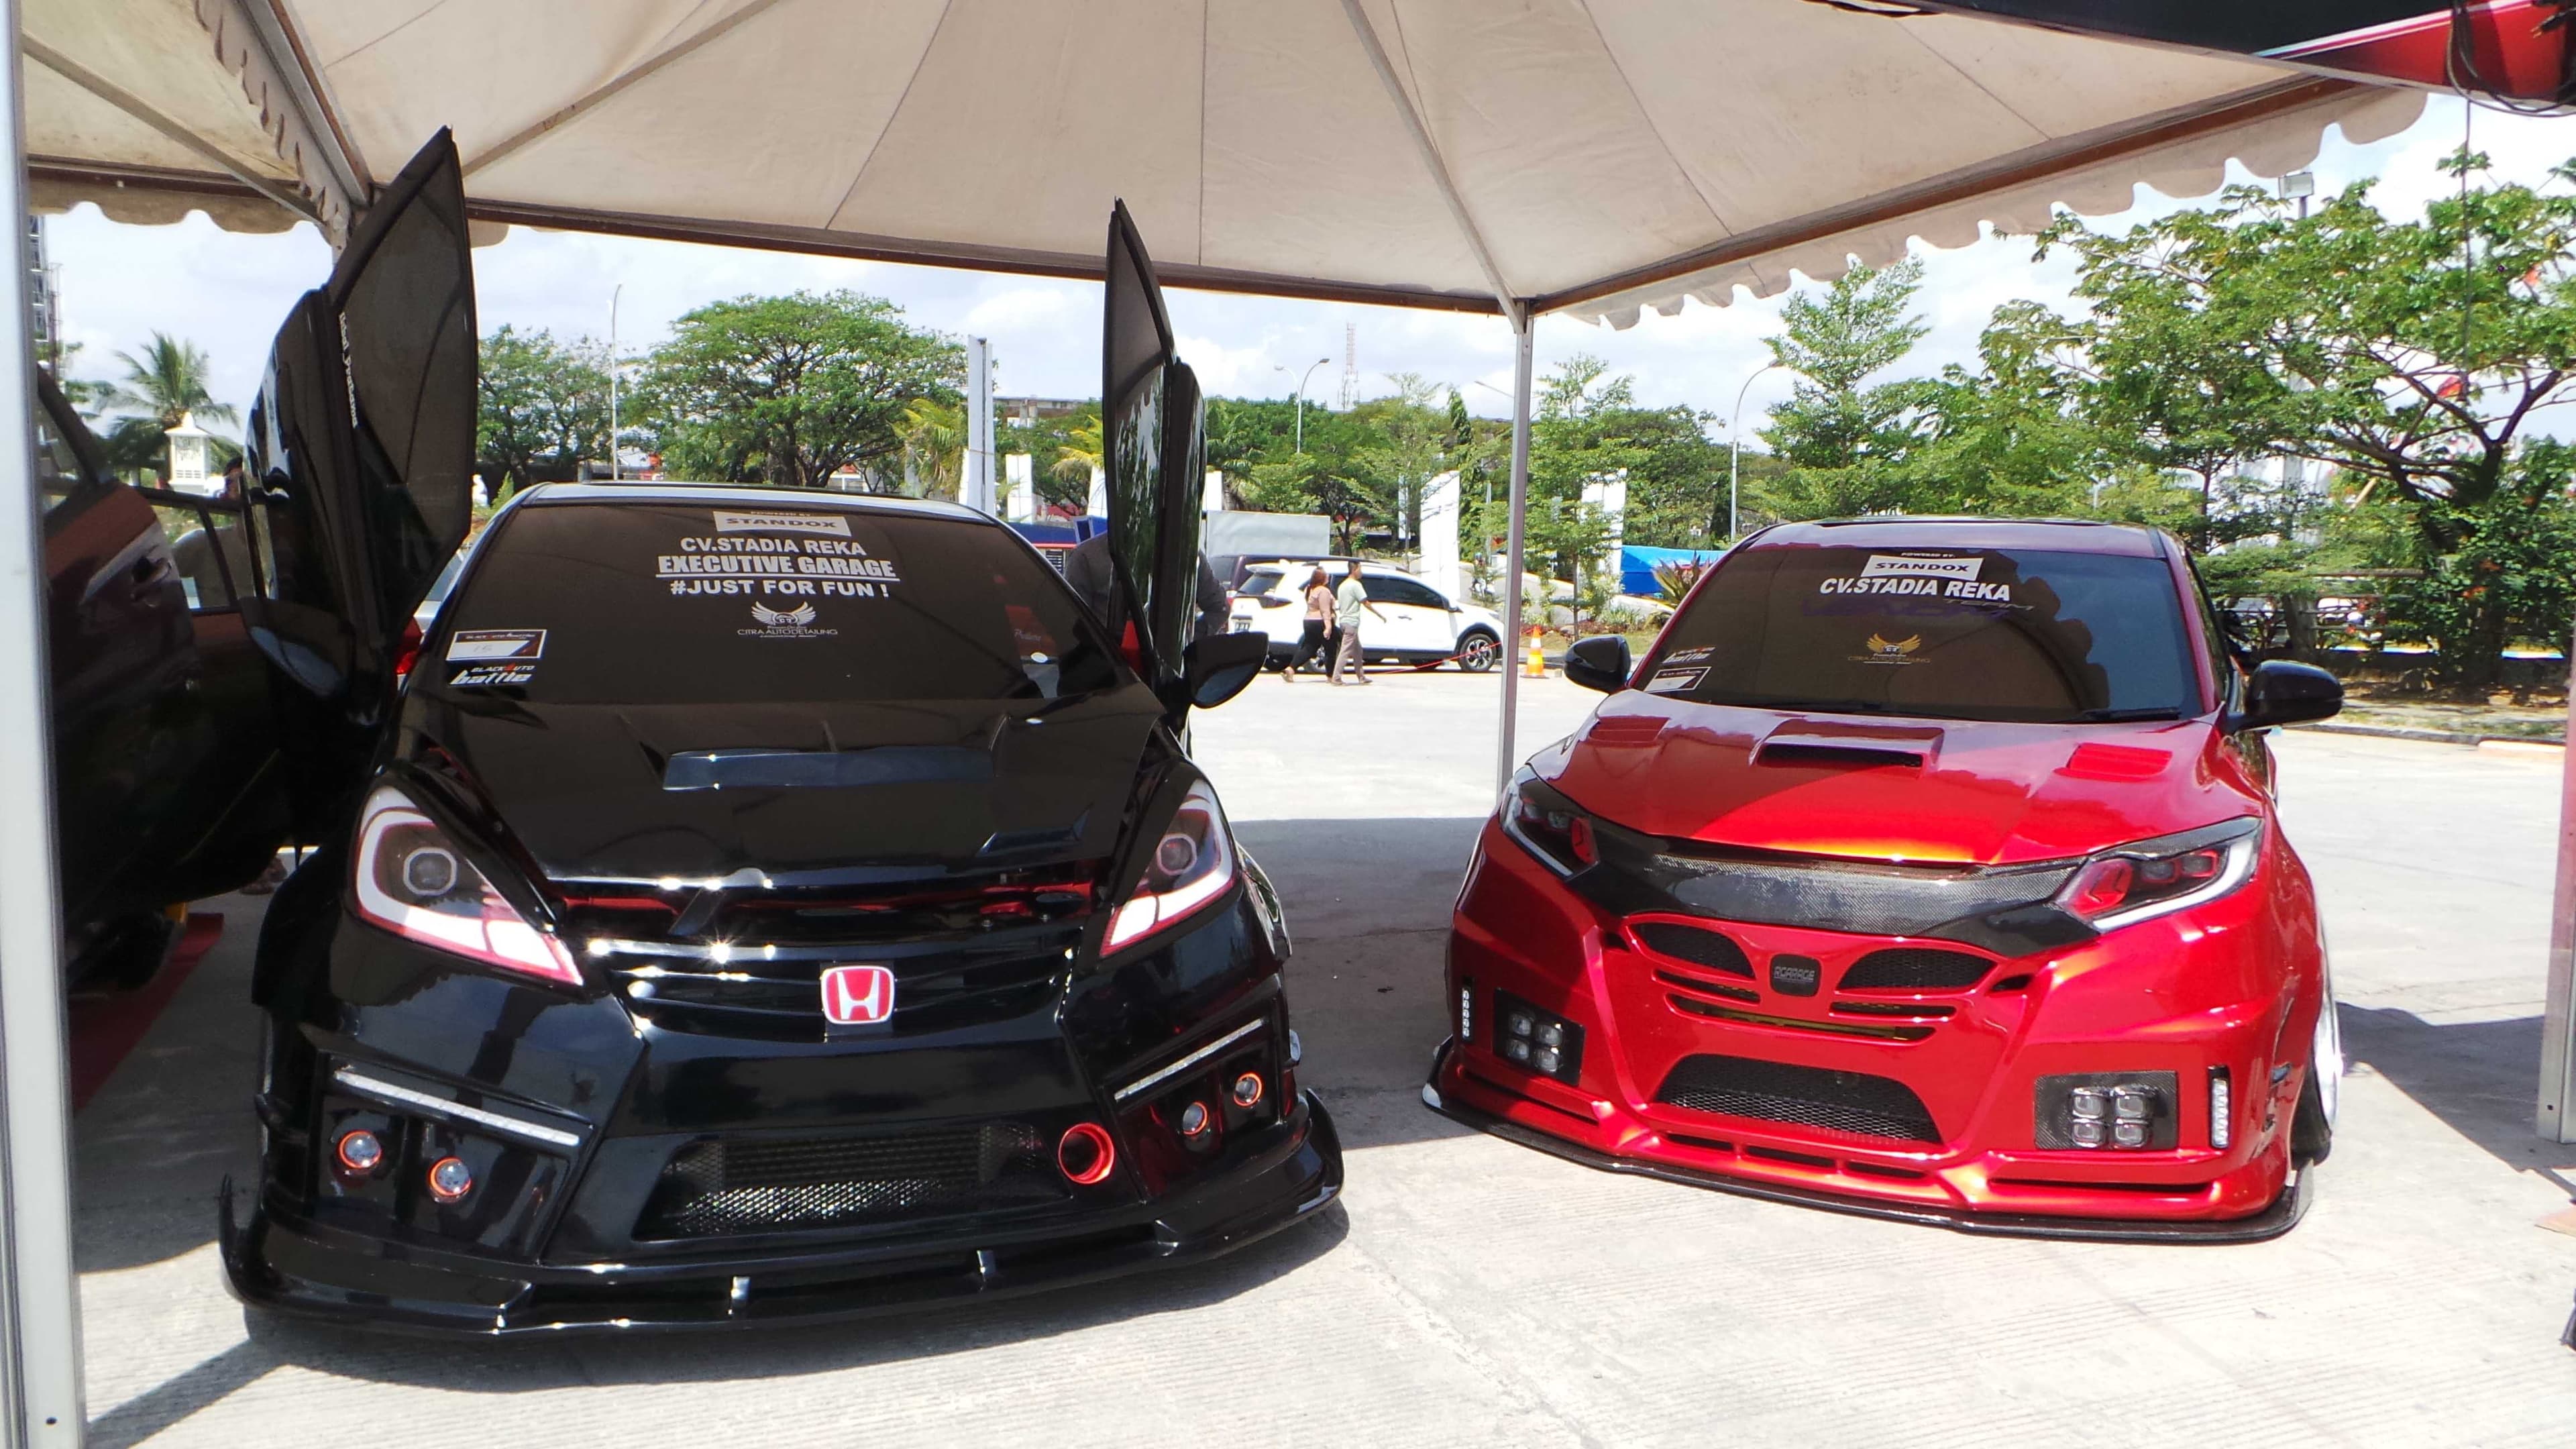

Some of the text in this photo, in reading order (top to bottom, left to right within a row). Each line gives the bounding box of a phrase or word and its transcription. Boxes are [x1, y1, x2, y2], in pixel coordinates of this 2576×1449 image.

[727, 518, 837, 528] STANDOX
[680, 537, 867, 555] CV.STADIA REKA
[657, 555, 896, 578] EXECUTIVE GARAGE
[1875, 561, 1970, 573] STANDOX
[670, 580, 755, 595] #JUST
[764, 580, 816, 595] FOR
[822, 582, 874, 597] FUN
[1820, 578, 2010, 601] CV.STADIA REKA
